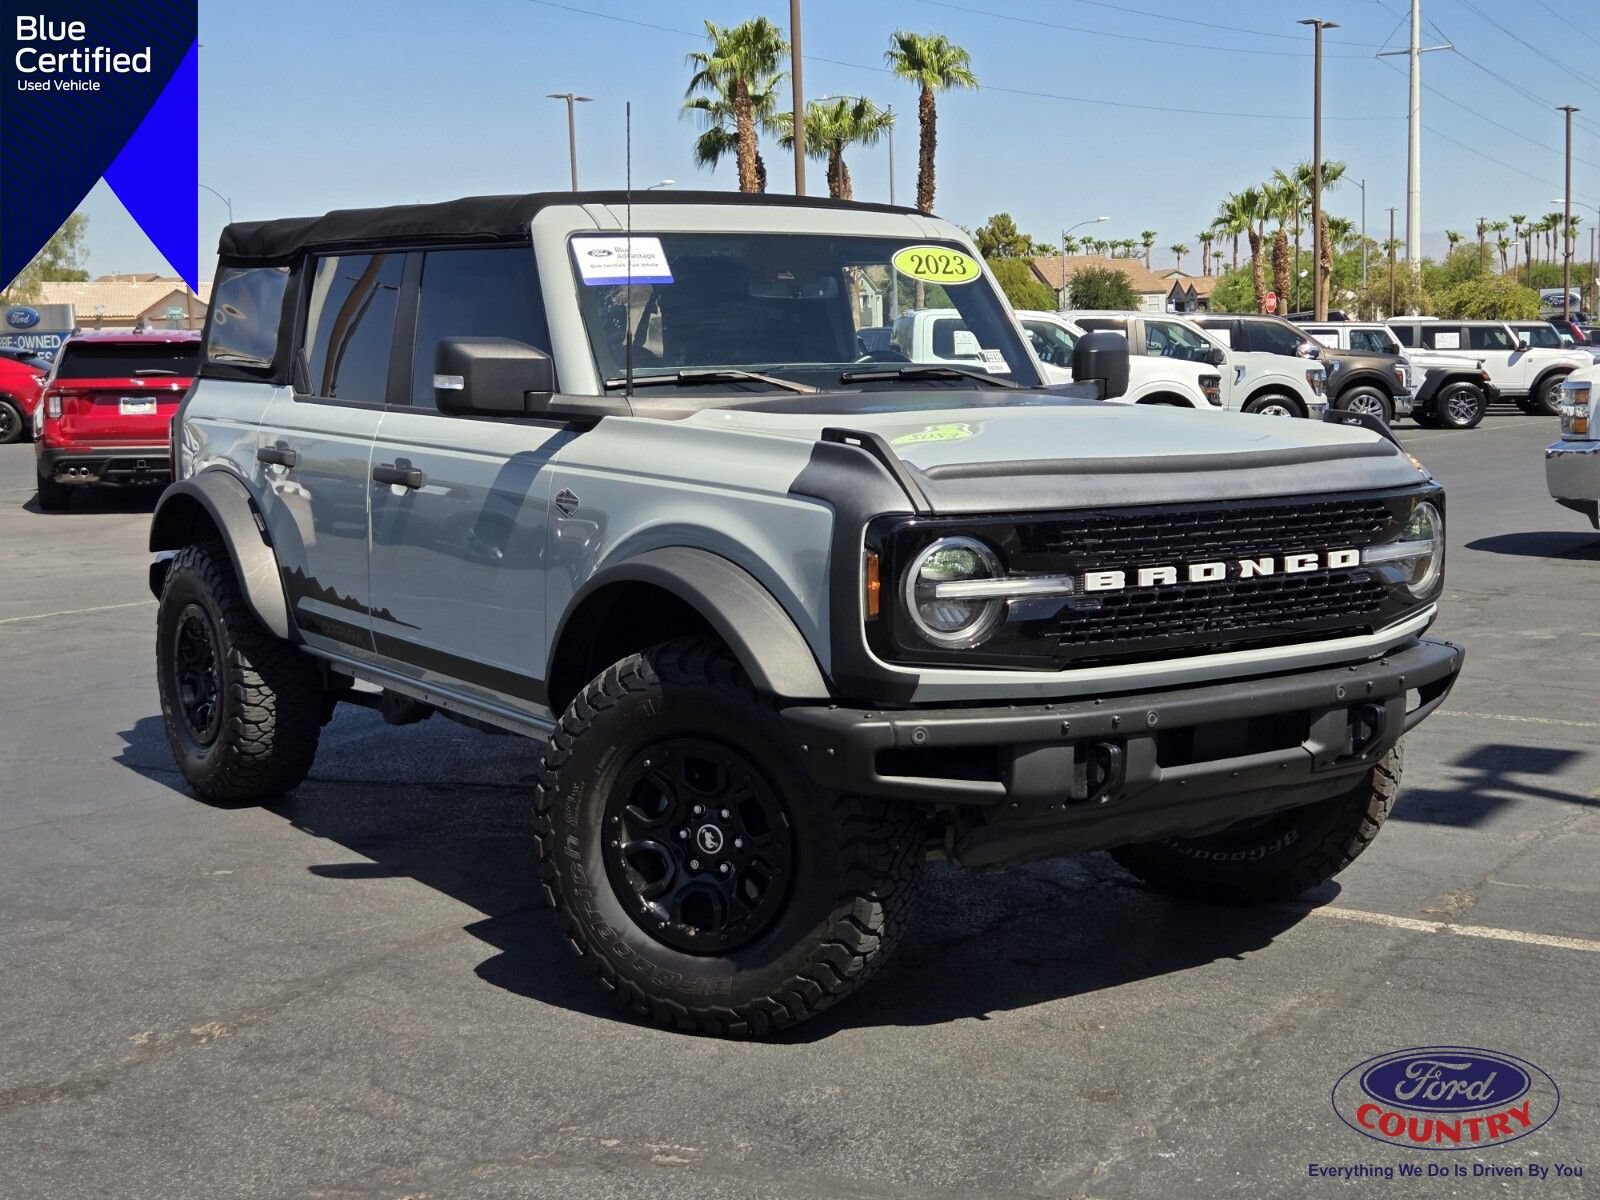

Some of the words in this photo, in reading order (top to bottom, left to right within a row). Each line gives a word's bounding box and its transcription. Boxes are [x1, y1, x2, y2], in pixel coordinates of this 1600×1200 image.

[910, 254, 967, 275] 2023
[11, 311, 30, 324] Ford
[0, 335, 61, 350] RE-OWNED
[1084, 549, 1360, 592] BRONCO
